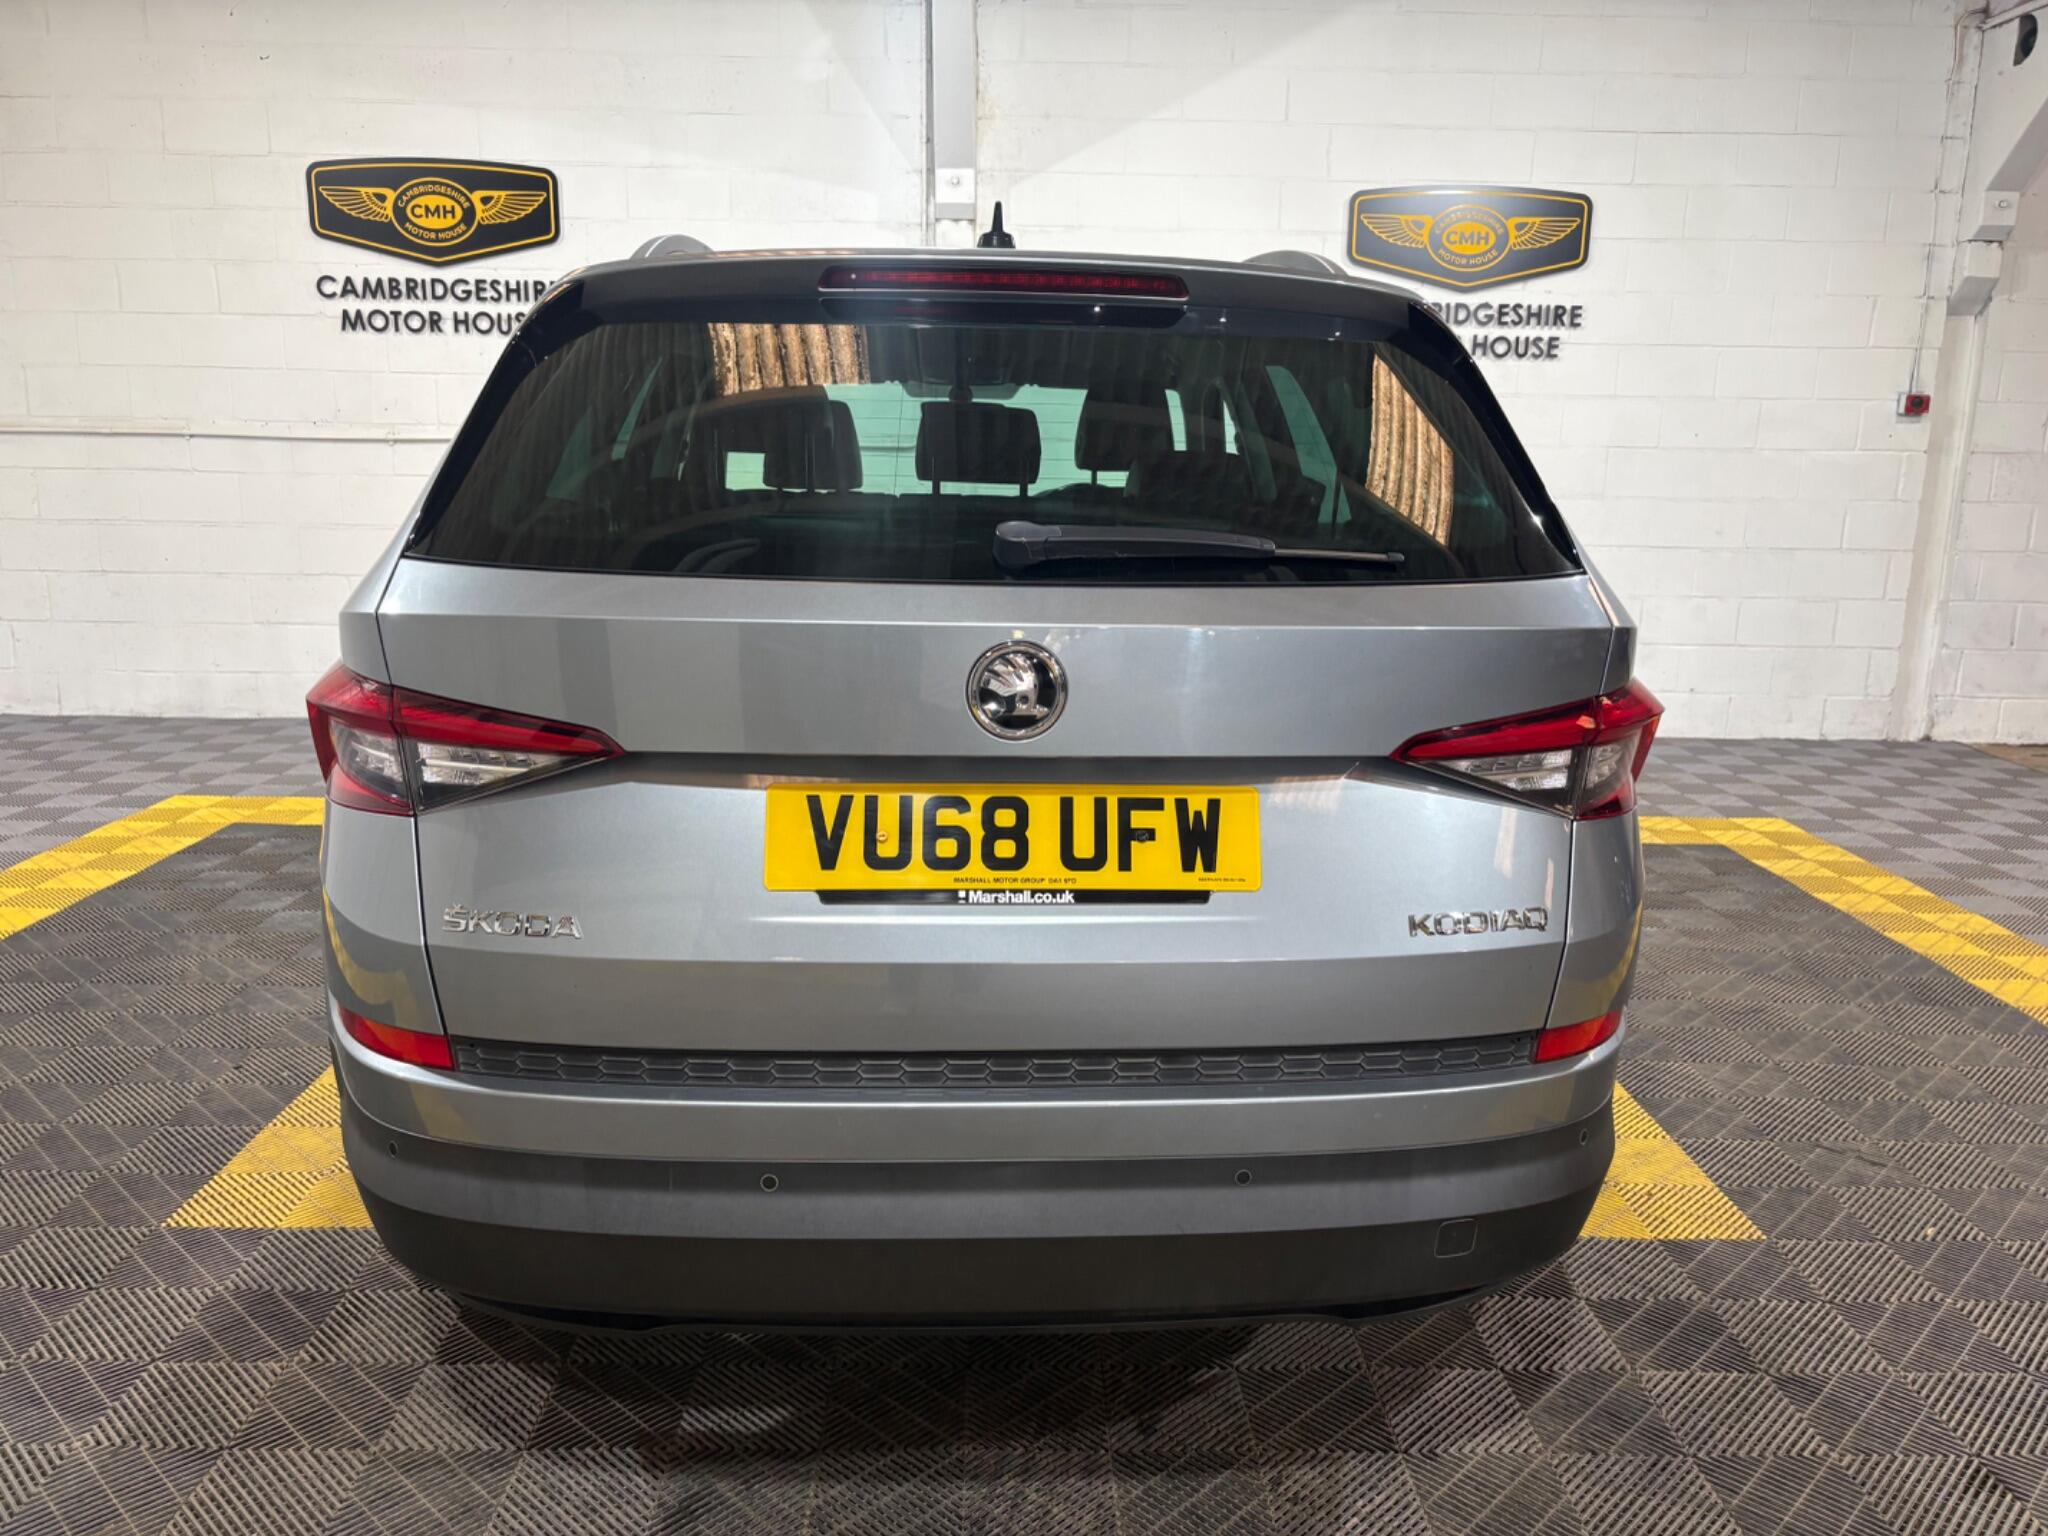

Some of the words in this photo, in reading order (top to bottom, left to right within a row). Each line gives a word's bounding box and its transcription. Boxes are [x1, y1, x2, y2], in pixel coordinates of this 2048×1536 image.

[398, 184, 471, 209] CAMBRIDGESHIRE
[410, 204, 456, 219] CMH
[403, 222, 437, 239] MOTOR
[438, 223, 468, 240] HOUSE
[1446, 231, 1491, 246] CMH
[1438, 249, 1468, 265] MOTOR
[1469, 248, 1498, 265] HOUSE
[316, 275, 557, 303] CAMBRIDGESHIR
[341, 309, 444, 334] MOTOR
[1471, 334, 1561, 359] HOUSE
[806, 794, 1030, 872] VU68
[1060, 796, 1221, 873] UFW
[968, 890, 1075, 904] Marshall.co.uk
[442, 902, 584, 939] ŠKODA
[1408, 907, 1549, 937] KODIAQ
